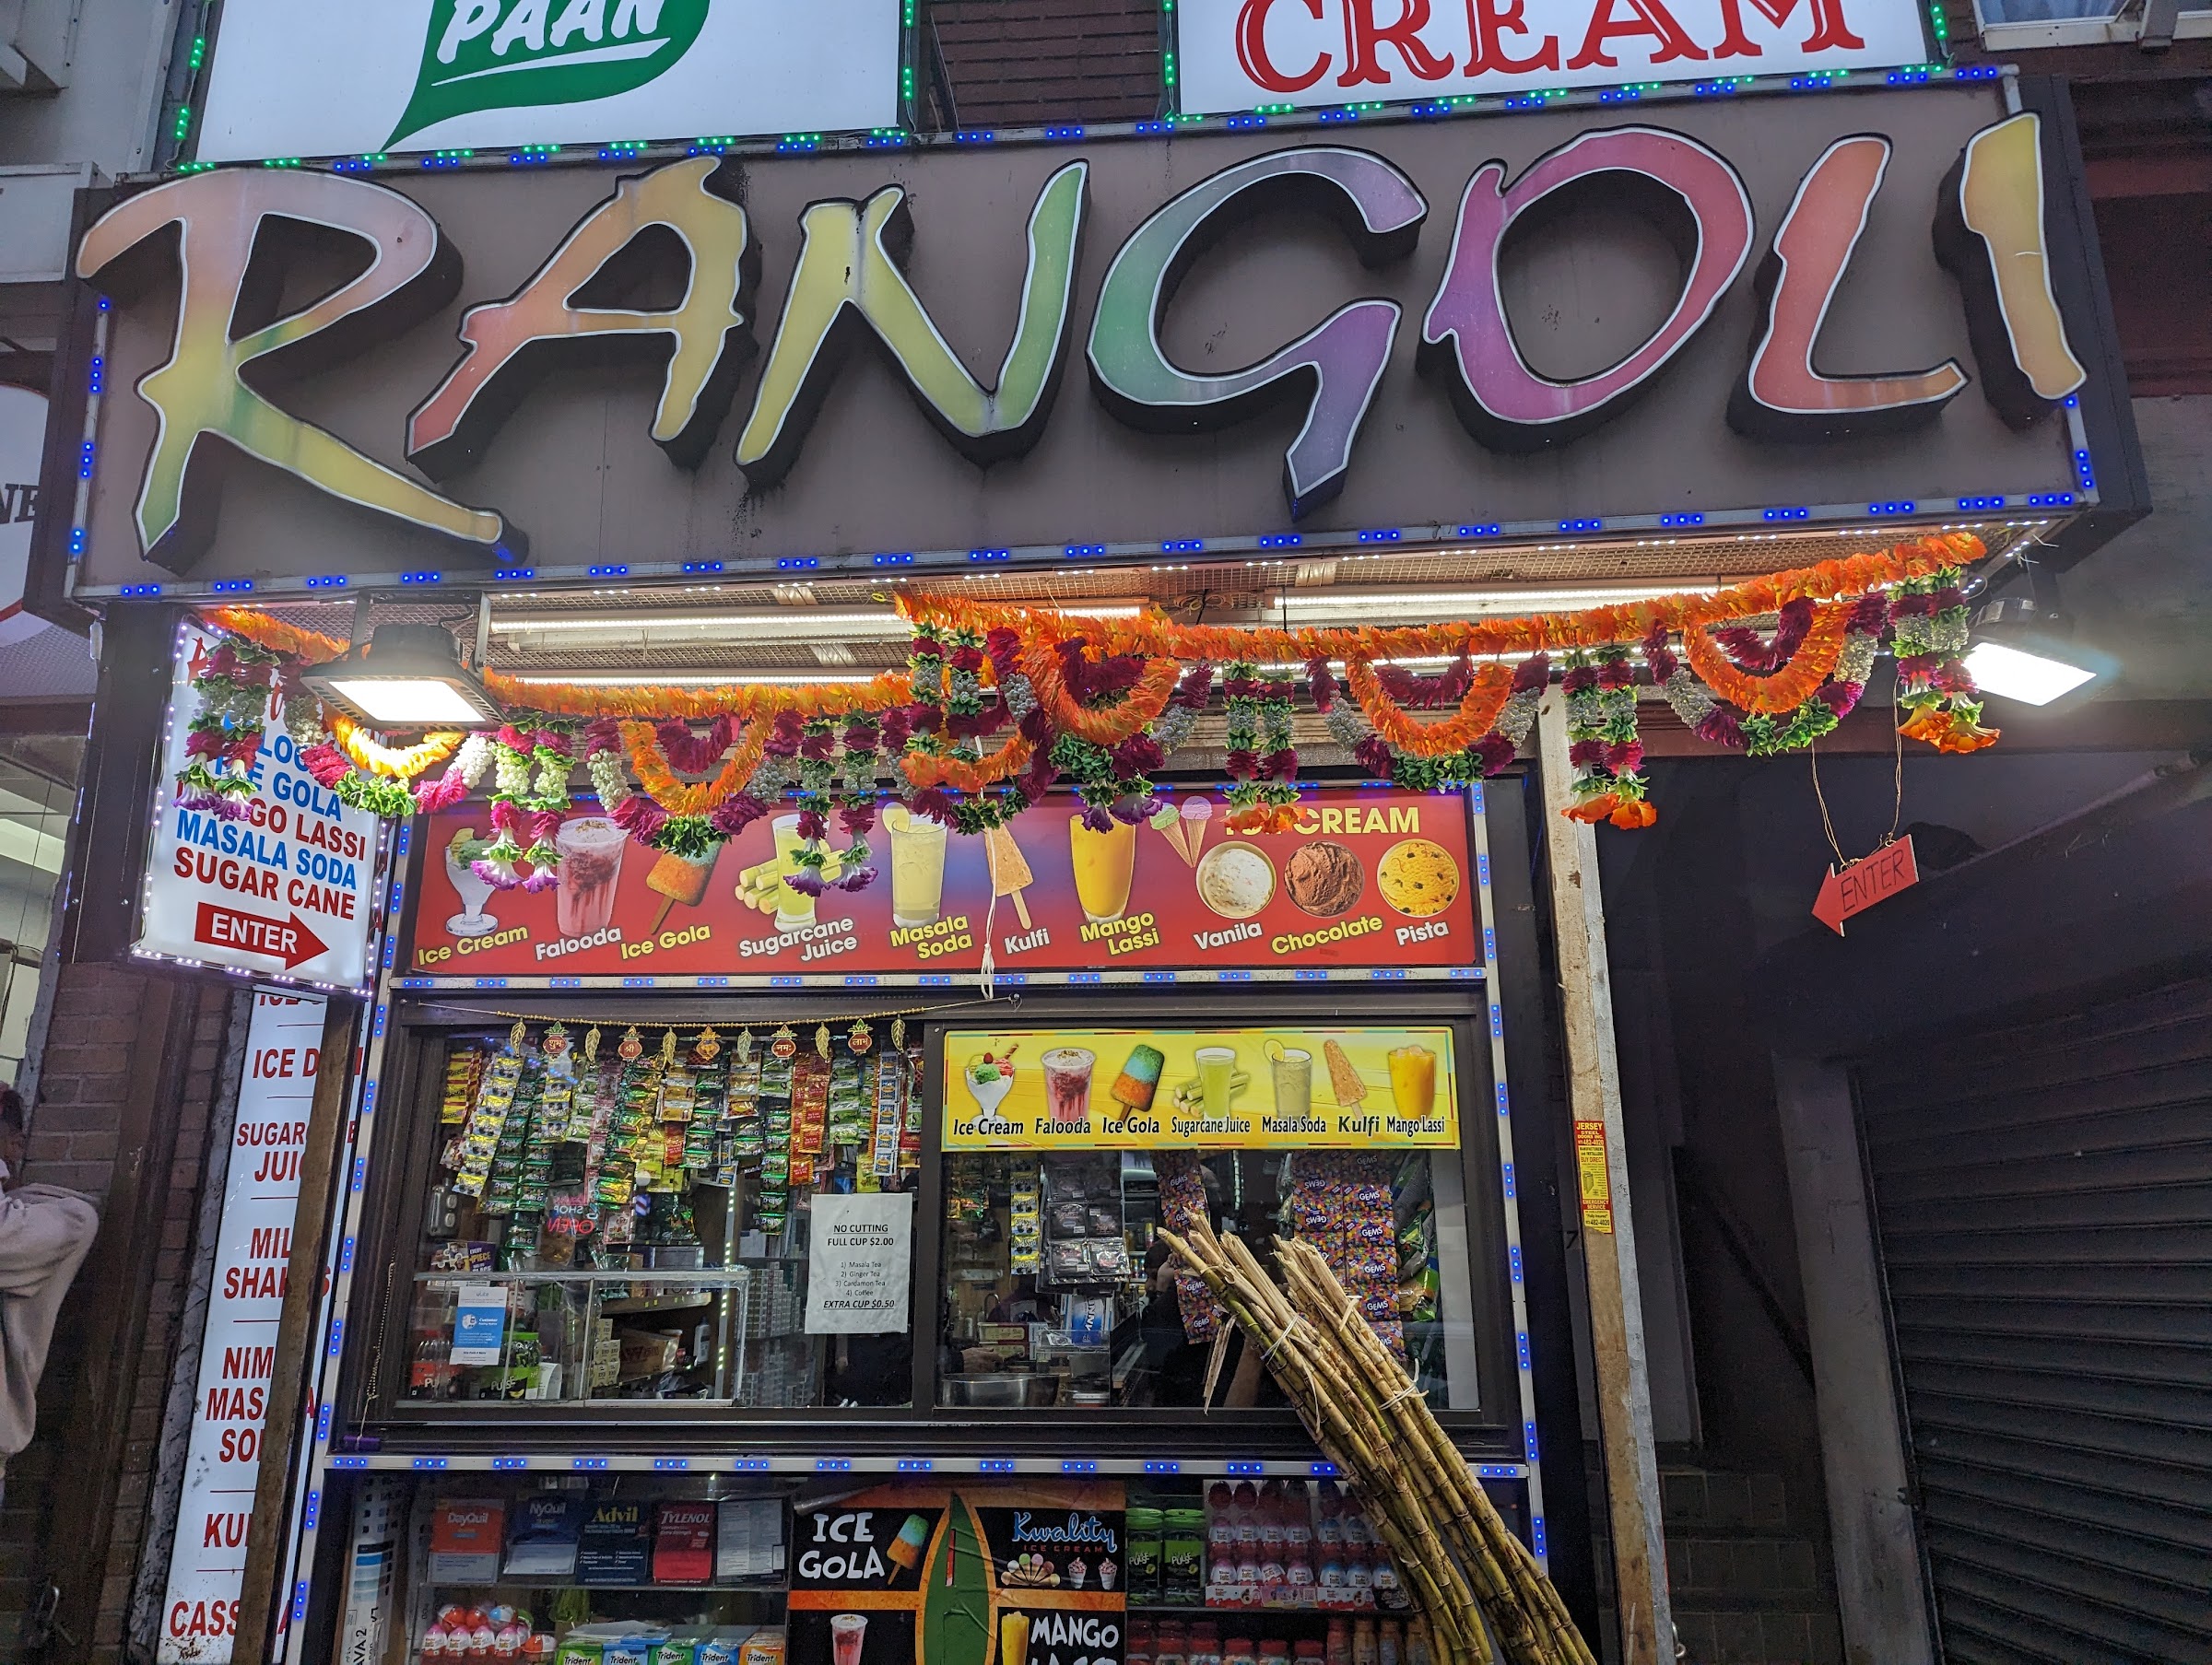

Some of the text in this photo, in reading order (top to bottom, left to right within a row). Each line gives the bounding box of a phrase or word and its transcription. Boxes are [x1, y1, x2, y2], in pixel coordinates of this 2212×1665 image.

[437, 0, 660, 64] PAAN
[1236, 0, 1864, 93] CREAM
[76, 111, 2088, 553] RANGOLI
[274, 771, 342, 822] GOLA
[1291, 806, 1420, 834] CREAM
[295, 814, 366, 861] LASSI
[176, 809, 358, 890] MASALA SODA
[173, 846, 356, 920] SUGAR CANE
[1841, 849, 1904, 913] ENTER
[210, 912, 298, 955] ENTER
[739, 917, 853, 958] Sugarcane
[890, 915, 969, 948] Masala
[1080, 912, 1155, 943] Mango
[1194, 920, 1264, 952] Vanila
[1272, 914, 1383, 956] Chocolate
[1396, 920, 1450, 947] Pista
[418, 925, 528, 966] Ice Cream
[535, 926, 622, 961] Falooda
[620, 923, 711, 960] Ice Gola
[800, 934, 857, 963] Juice
[918, 932, 973, 960] Soda
[1004, 926, 1050, 956] Kulfi
[1109, 929, 1160, 956] Lassi
[253, 1049, 296, 1078] ICE
[953, 1118, 1024, 1136] Ice Cream
[1035, 1117, 1091, 1135] Falooda
[1102, 1116, 1160, 1134] Ice Gola
[1171, 1117, 1251, 1137] Sugarcane Juice
[1262, 1117, 1327, 1133] Masala Soda
[1338, 1115, 1381, 1133] Kulfi
[1386, 1117, 1445, 1137] Mango Lassi
[1576, 1122, 1603, 1131] JERSEY
[254, 1151, 304, 1181] JUI
[1359, 1190, 1380, 1202] GEMS
[833, 1224, 888, 1233] NO CUTTING
[1361, 1226, 1382, 1237] GEMS
[250, 1228, 292, 1259] MIL
[828, 1237, 894, 1247] FULL CUP $2.00
[849, 1271, 869, 1279] Ginger
[1364, 1263, 1385, 1273] GEMS
[823, 1299, 895, 1308] EXTRA CUP $0.50
[1367, 1300, 1389, 1311] GEMS
[1194, 1316, 1210, 1328] GEMS
[490, 1376, 516, 1390] PUSE
[448, 1512, 488, 1527] DayQuil
[529, 1502, 568, 1516] NyQuil
[592, 1506, 639, 1523] Advil
[661, 1510, 710, 1525] TYLENOL
[812, 1512, 875, 1542] ICE
[1012, 1511, 1118, 1554] Kwality
[1023, 1544, 1103, 1554] ICE CREAM
[1128, 1552, 1150, 1565] PULSE
[1171, 1552, 1193, 1565] PULSE
[798, 1546, 885, 1579] GOLA
[1030, 1612, 1120, 1648] MANGO
[564, 1656, 592, 1665] Trident
[609, 1656, 638, 1665] Trident
[656, 1652, 684, 1660] Trident
[701, 1653, 729, 1662] Trident
[747, 1653, 774, 1662] Trident
